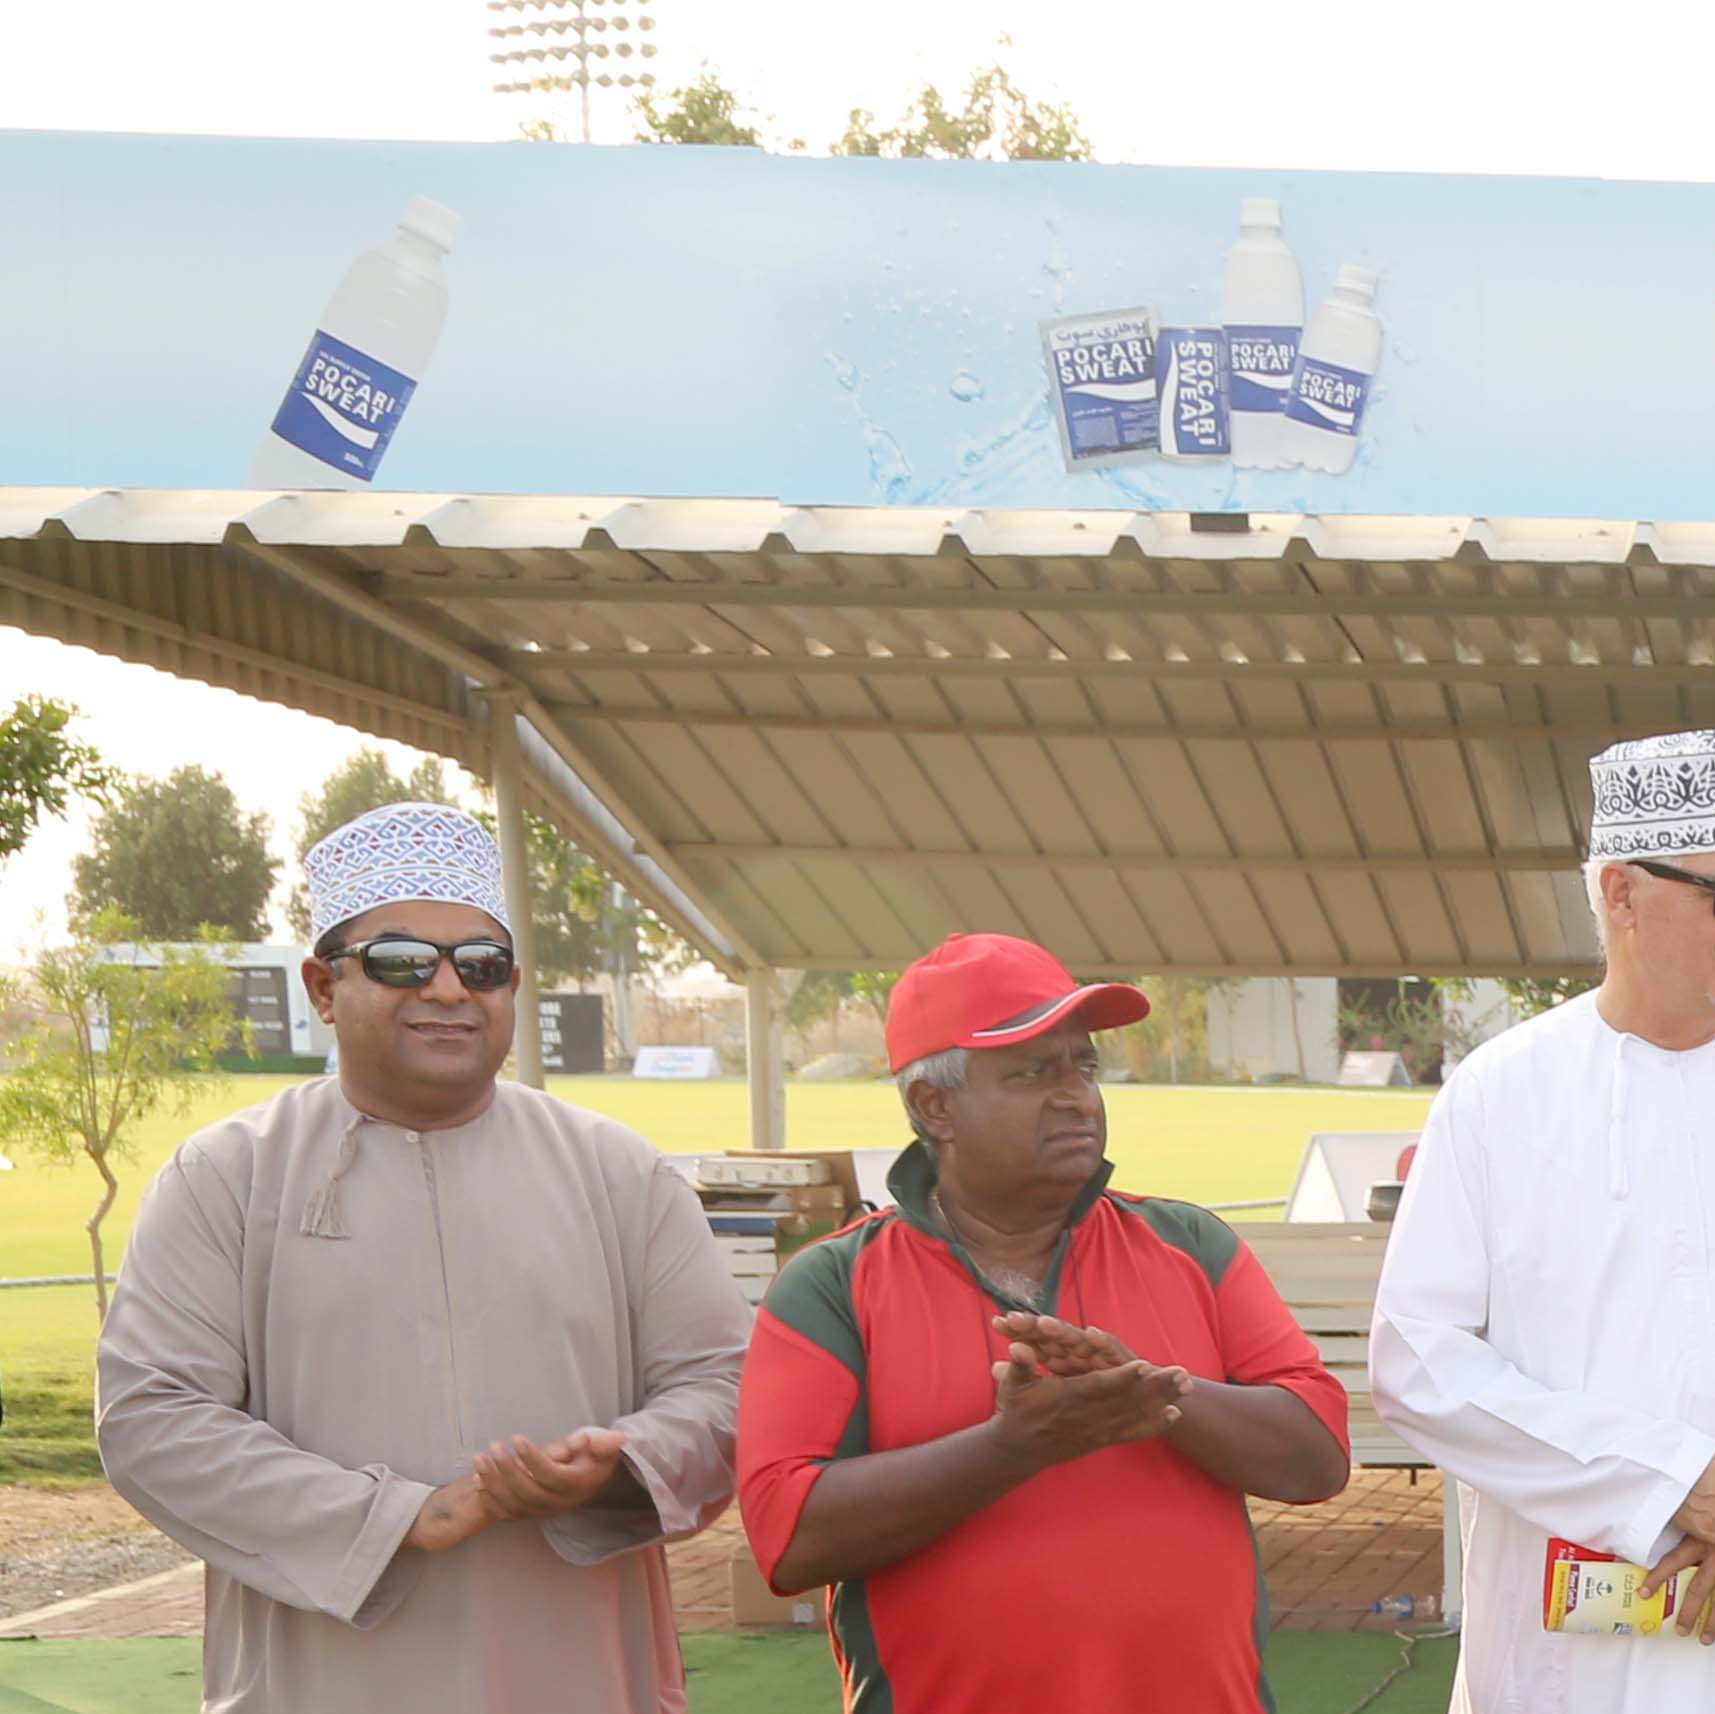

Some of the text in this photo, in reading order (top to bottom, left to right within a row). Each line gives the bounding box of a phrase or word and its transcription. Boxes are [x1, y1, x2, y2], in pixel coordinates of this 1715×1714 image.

[1057, 338, 1153, 367] POCARI
[1231, 344, 1295, 358] POCARI
[1231, 356, 1290, 370] SWEAT
[1060, 356, 1146, 384] SWEAT
[312, 358, 396, 413] POCARI
[1178, 340, 1199, 436] SWEAT
[1195, 341, 1216, 445] POCARI
[1299, 383, 1354, 408] SWEAT
[1302, 371, 1361, 398] POCARI
[305, 375, 384, 423] SWEAT
